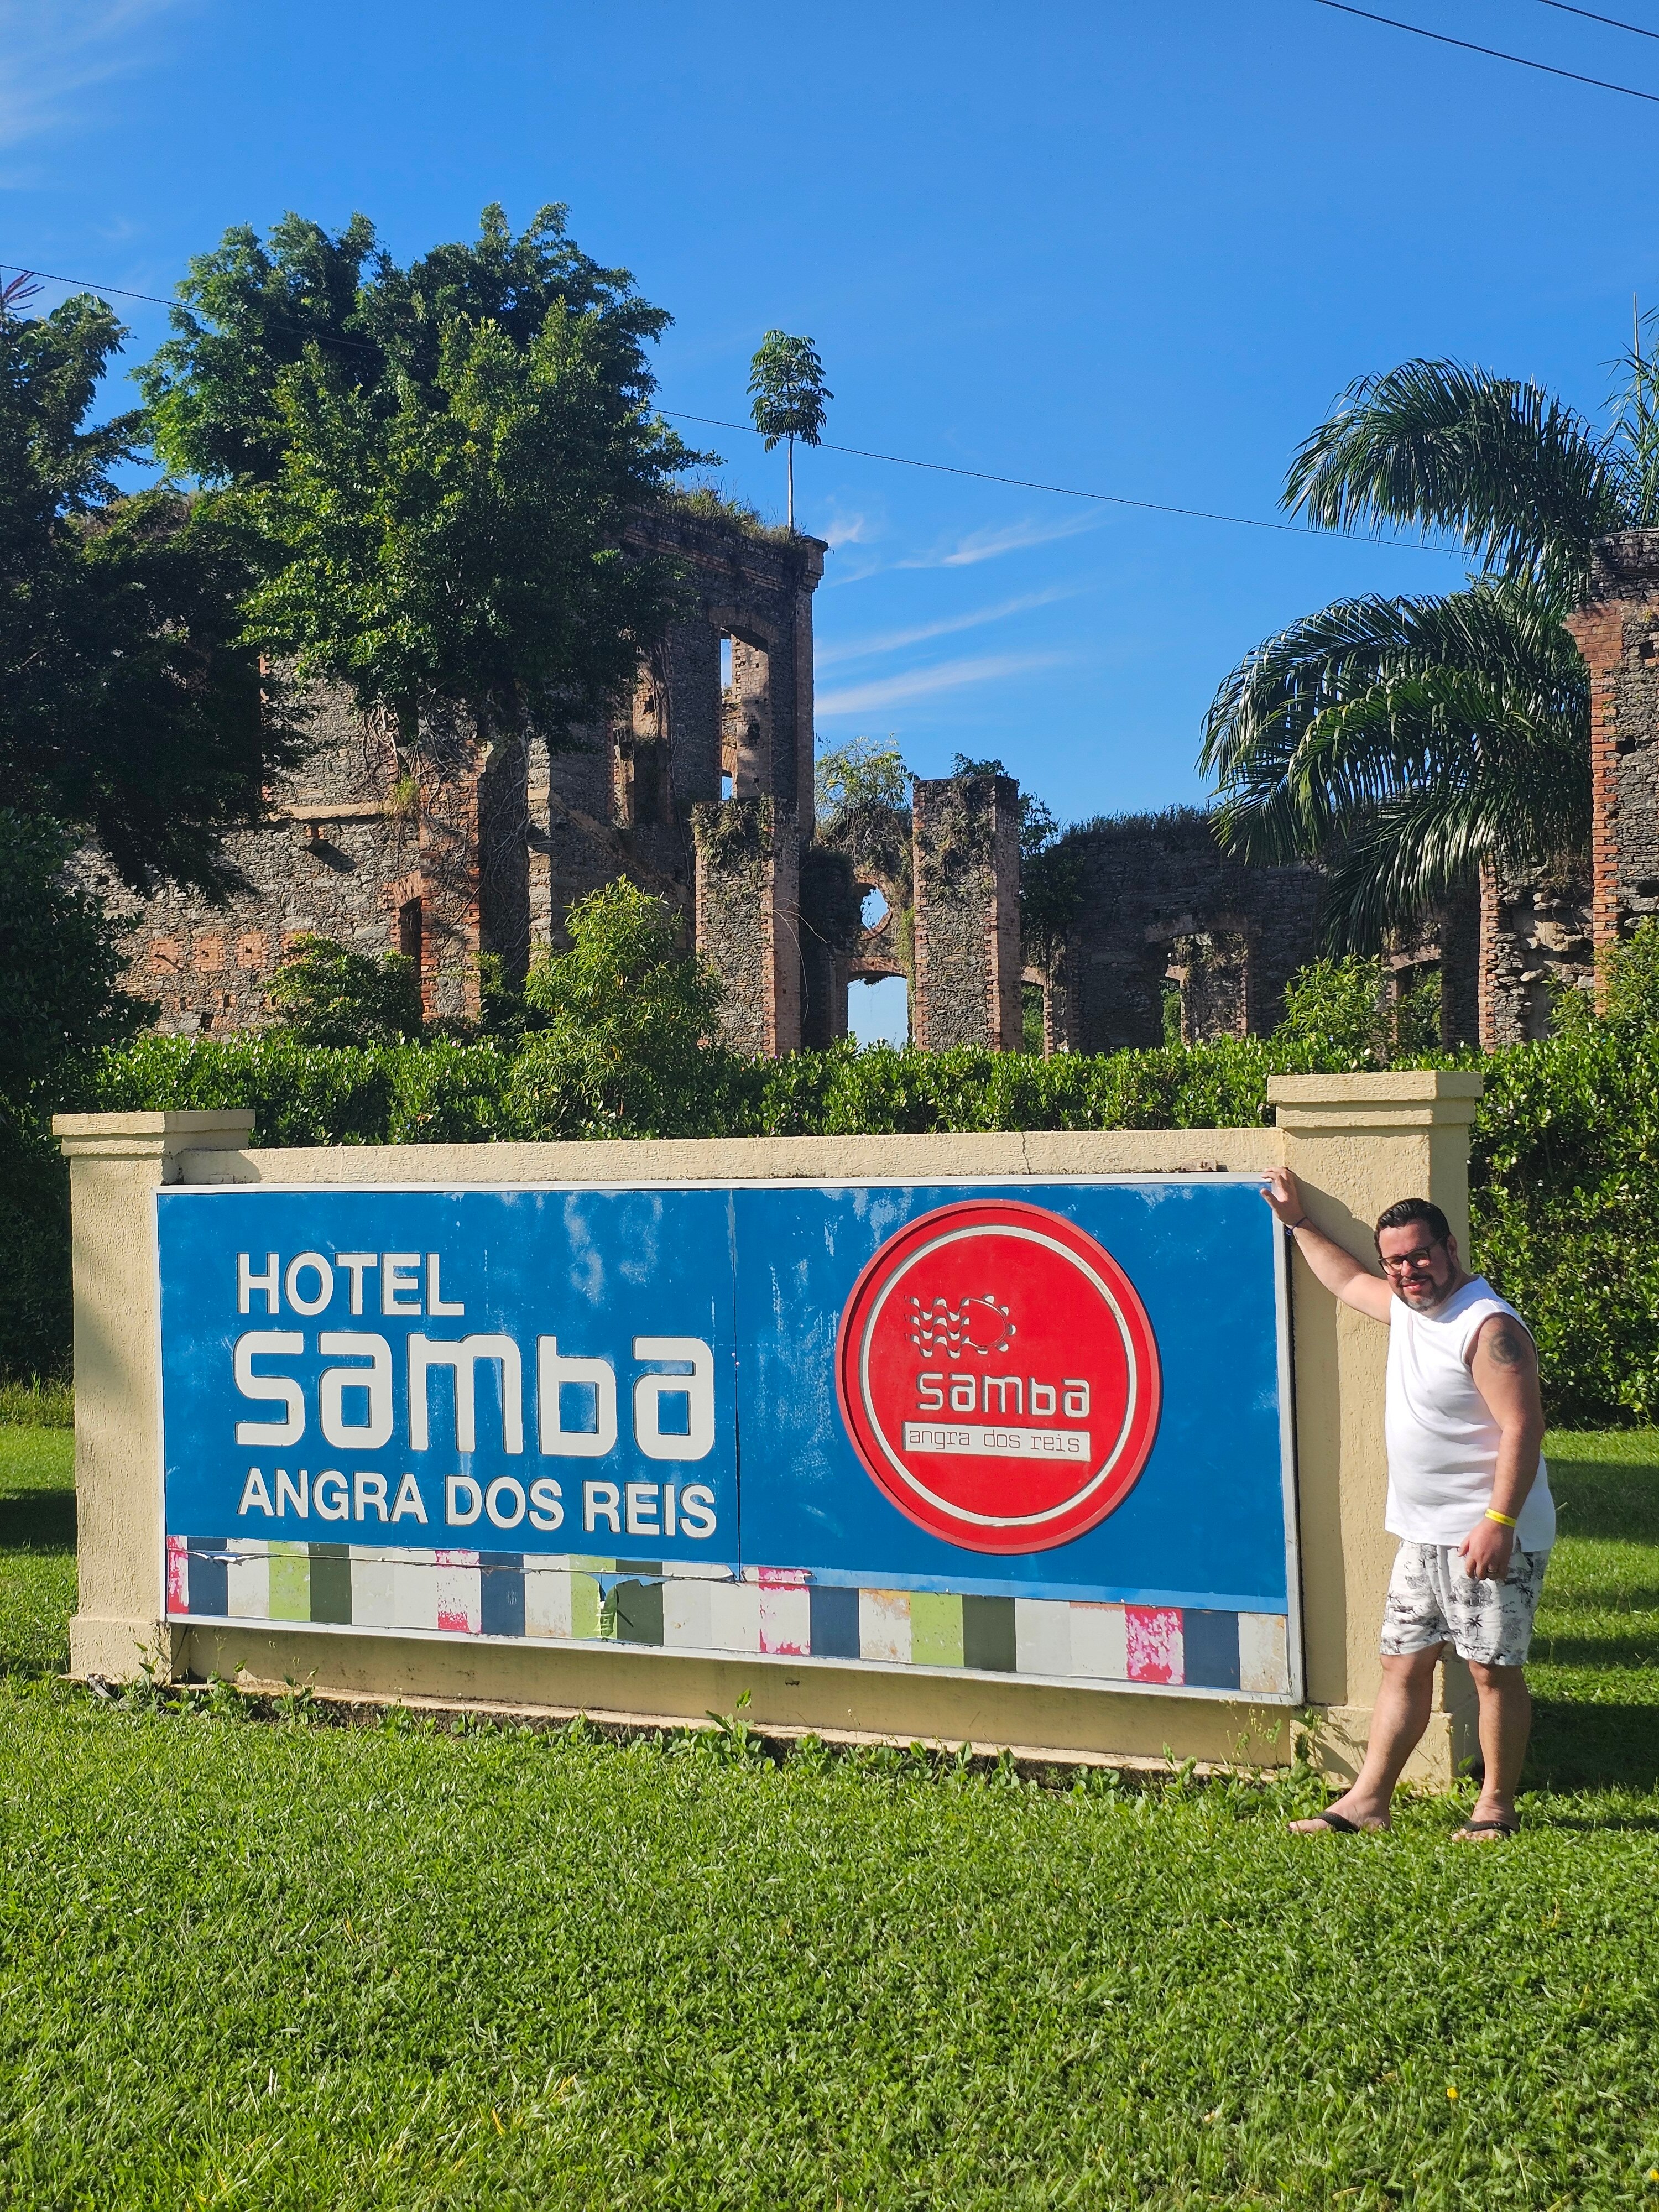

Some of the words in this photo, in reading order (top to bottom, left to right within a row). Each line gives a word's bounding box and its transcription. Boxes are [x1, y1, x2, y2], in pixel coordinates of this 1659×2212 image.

[237, 1252, 464, 1316] HOTEL
[234, 1331, 714, 1460] samba
[916, 1372, 1091, 1418] samba
[909, 1430, 970, 1450] angra
[983, 1429, 1020, 1448] dos
[1030, 1434, 1080, 1453] reis
[237, 1467, 428, 1524] ANGRA
[445, 1474, 564, 1531] DOS
[583, 1479, 717, 1538] REIS
